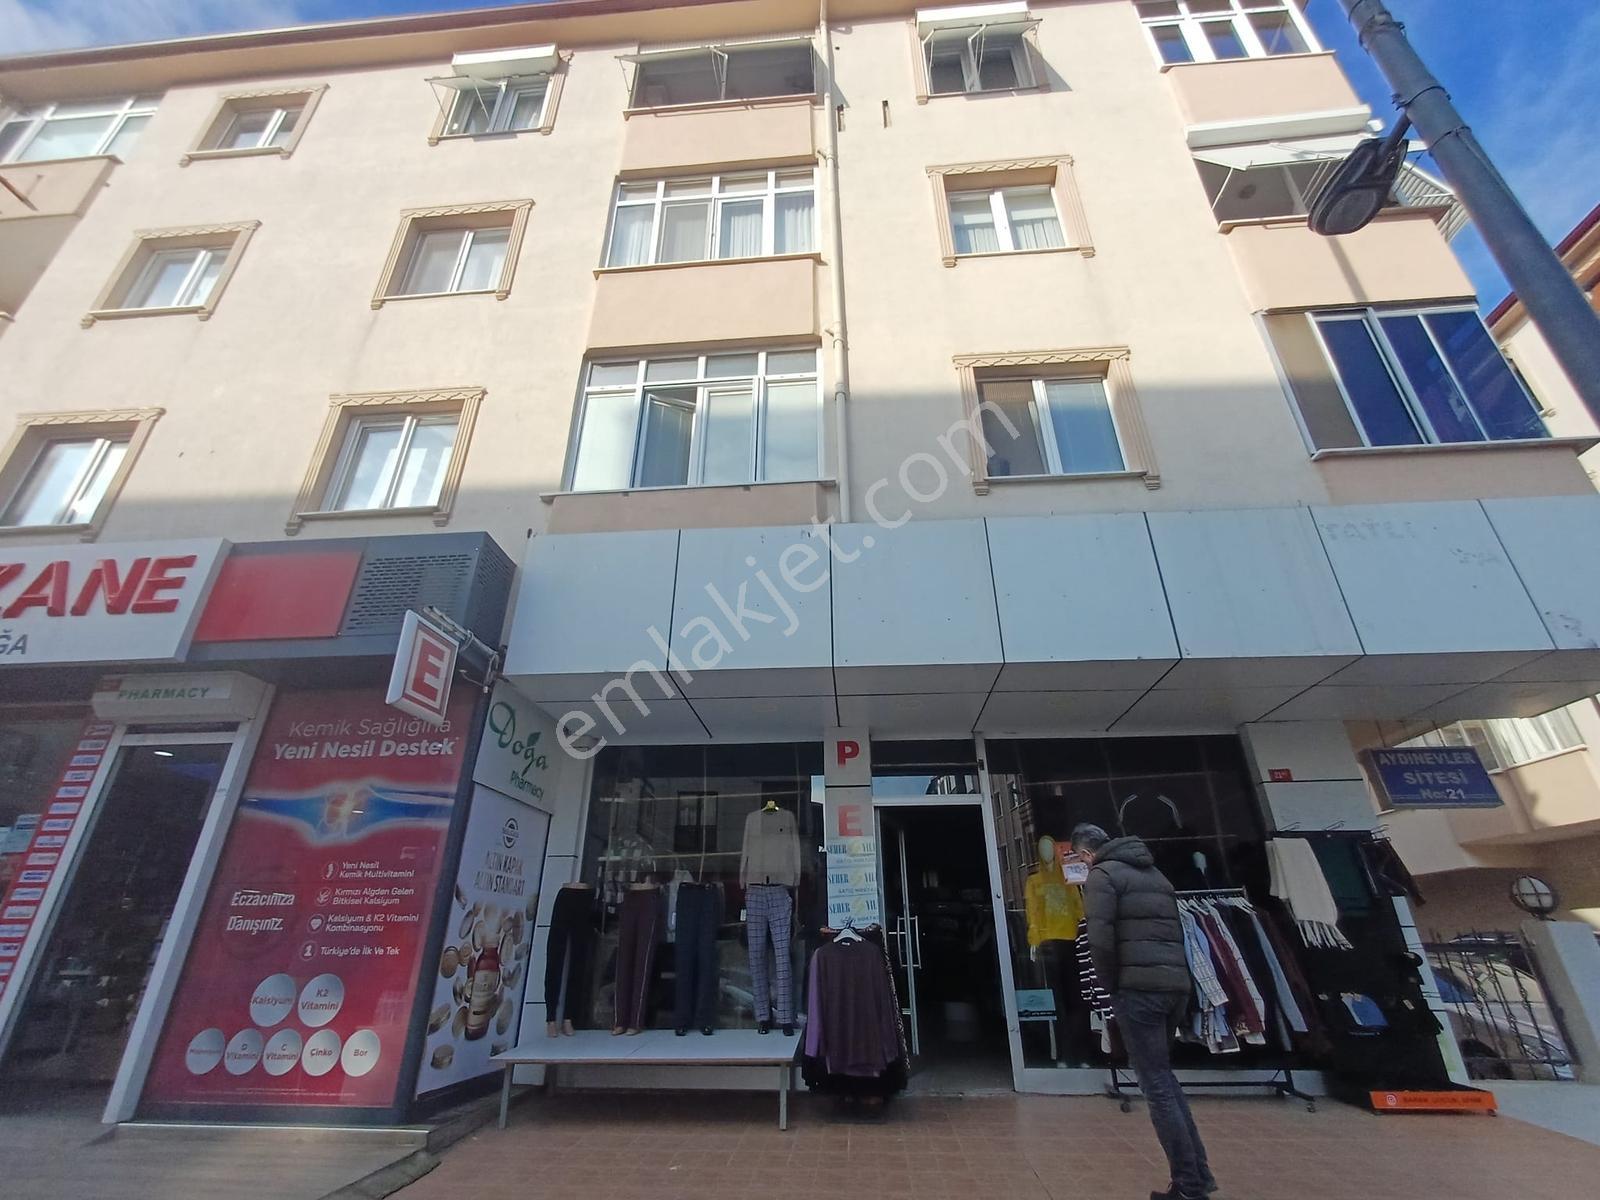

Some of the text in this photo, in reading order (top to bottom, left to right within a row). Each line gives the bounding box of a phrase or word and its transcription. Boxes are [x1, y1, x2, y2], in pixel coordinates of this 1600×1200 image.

[412, 638, 445, 702] E
[117, 687, 210, 700] PHARMACY
[289, 719, 351, 737] Kemik
[274, 738, 456, 759] Yeni Nesil Destek
[1380, 752, 1476, 765] AYDINEVLER
[1403, 769, 1468, 785] SİTESİ
[360, 861, 379, 869] Nesil
[340, 870, 414, 879] Kemik Multivitamini
[231, 890, 295, 906] Eczacınıza
[363, 897, 400, 906] Kalsiyum
[328, 914, 364, 923] Kalsiyum
[374, 914, 385, 922] K2
[386, 914, 419, 922] Vitamini
[326, 925, 384, 933] Kombinasyonu
[374, 947, 384, 955] Ve
[386, 946, 400, 954] Tek
[316, 989, 329, 997] K2
[301, 1002, 339, 1011] Vitamini
[310, 1049, 333, 1057] Çinko
[353, 1049, 368, 1057] Bor
